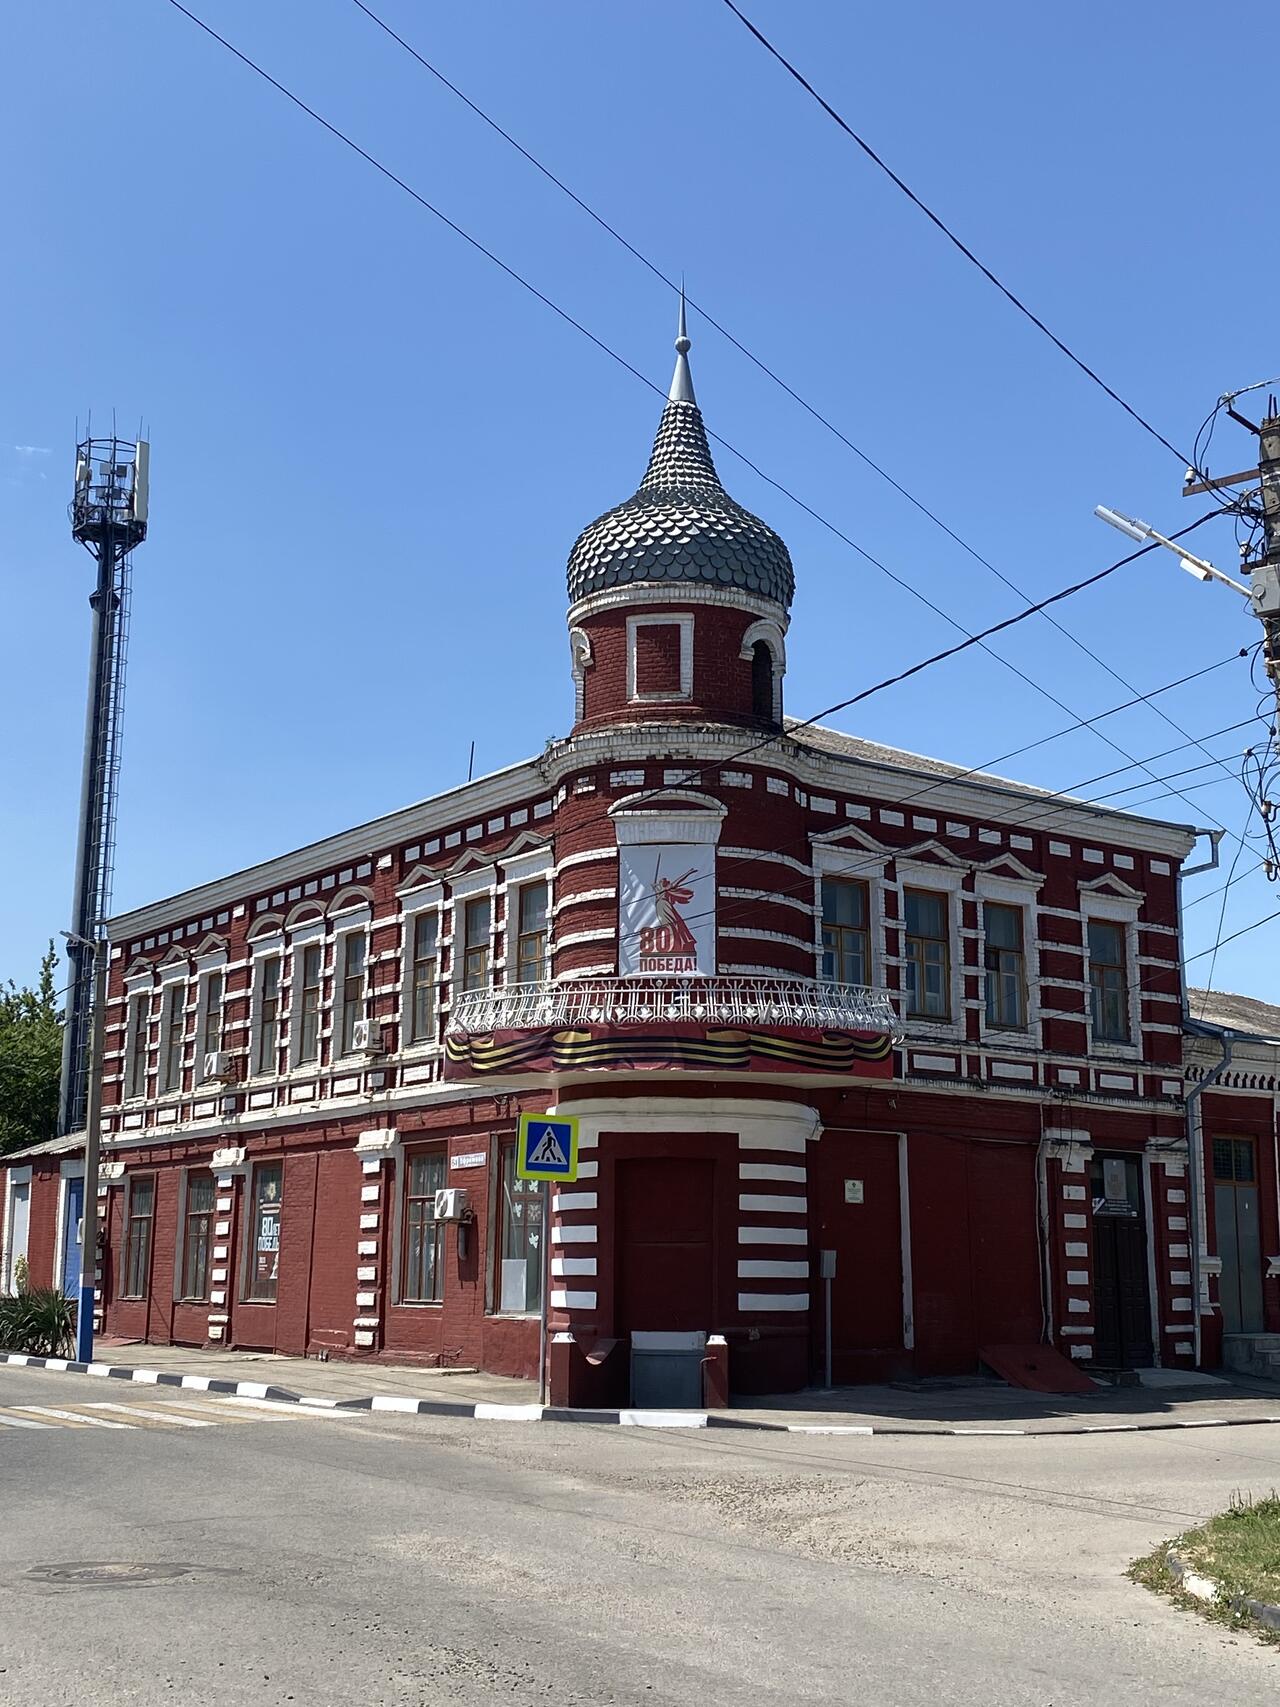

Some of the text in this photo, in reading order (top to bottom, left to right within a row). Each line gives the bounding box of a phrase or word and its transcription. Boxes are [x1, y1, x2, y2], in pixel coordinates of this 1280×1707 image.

[640, 927, 671, 952] 80
[640, 958, 697, 973] ПОБЕДА!
[261, 1216, 273, 1236] 80
